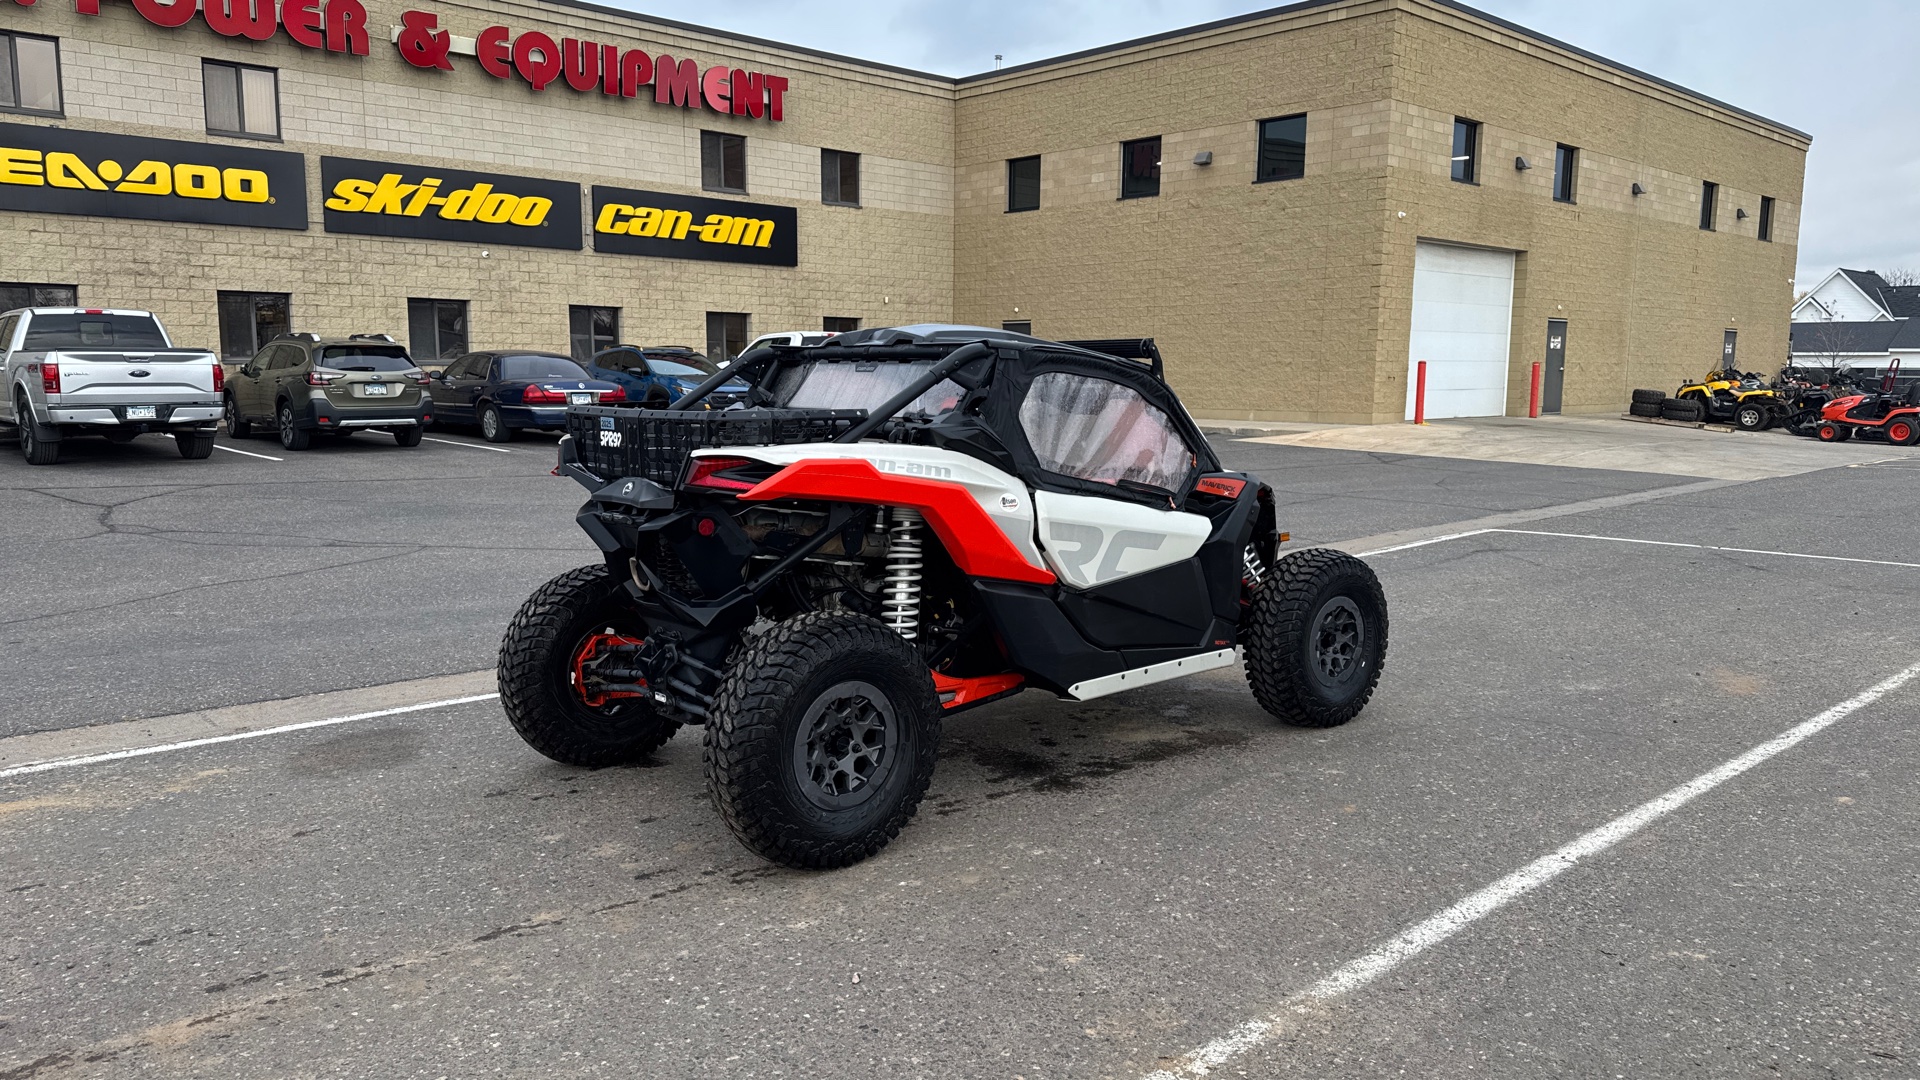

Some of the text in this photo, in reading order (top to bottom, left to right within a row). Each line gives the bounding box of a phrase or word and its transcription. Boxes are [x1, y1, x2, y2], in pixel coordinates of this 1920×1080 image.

[76, 0, 789, 122] WER & EQUIPMENT
[325, 173, 553, 226] ski-doo
[595, 203, 776, 248] can-am
[840, 456, 951, 478] n-am
[1201, 480, 1236, 492] MAVERICK
[1049, 521, 1167, 584] RC
